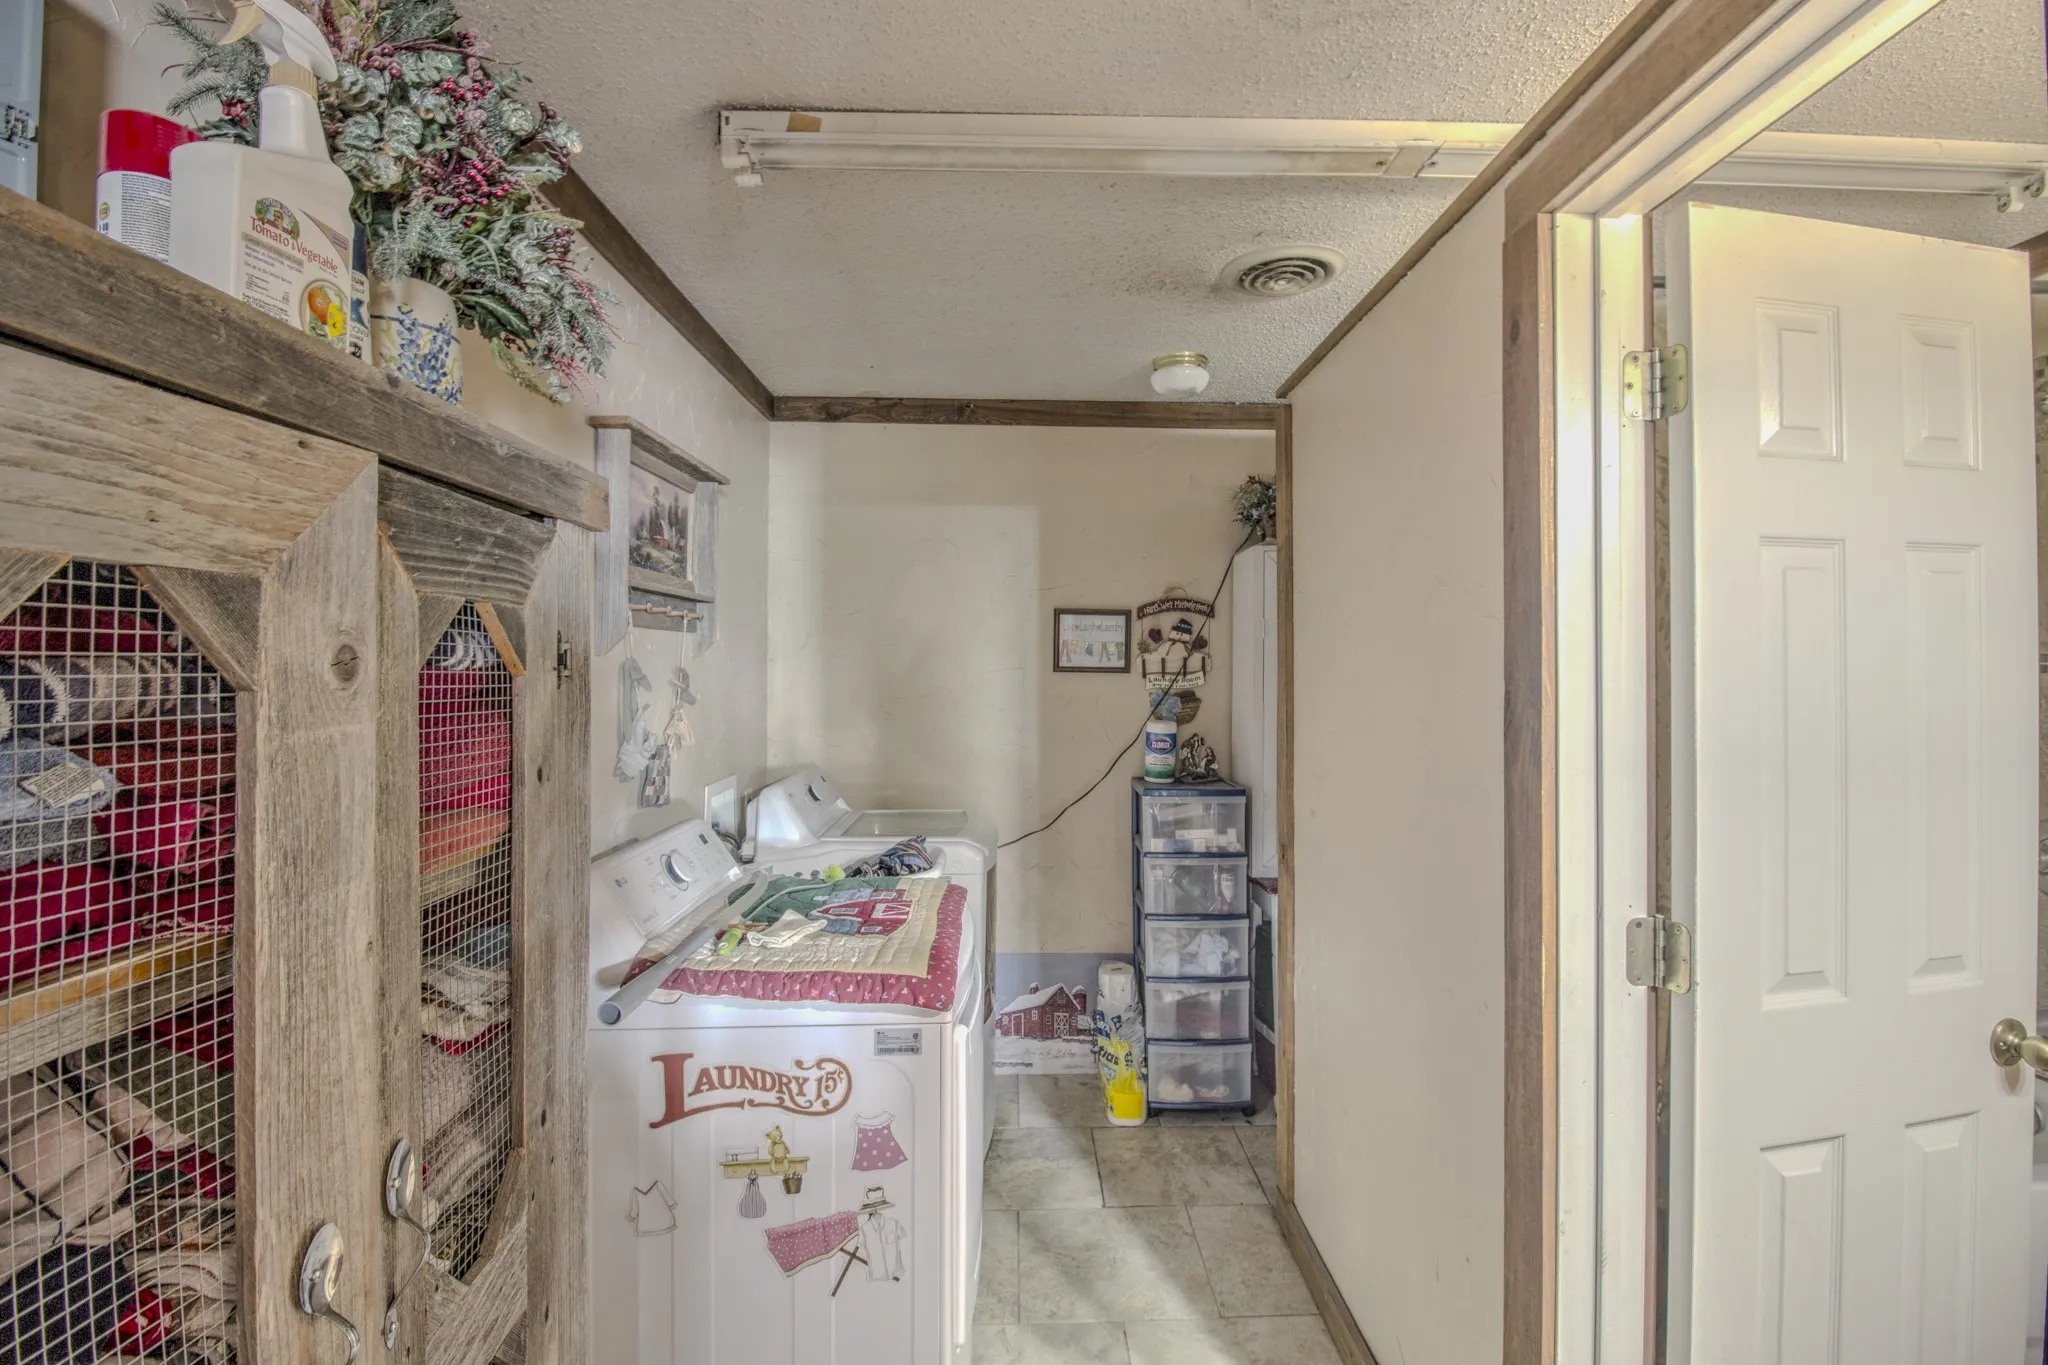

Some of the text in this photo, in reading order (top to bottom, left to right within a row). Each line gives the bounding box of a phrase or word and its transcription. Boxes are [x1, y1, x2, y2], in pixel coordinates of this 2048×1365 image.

[250, 216, 290, 247] Tomato
[295, 239, 338, 274] Vegetable
[1148, 675, 1202, 684] Laundy Room
[649, 1053, 845, 1129] LAUNDRY 15¢
